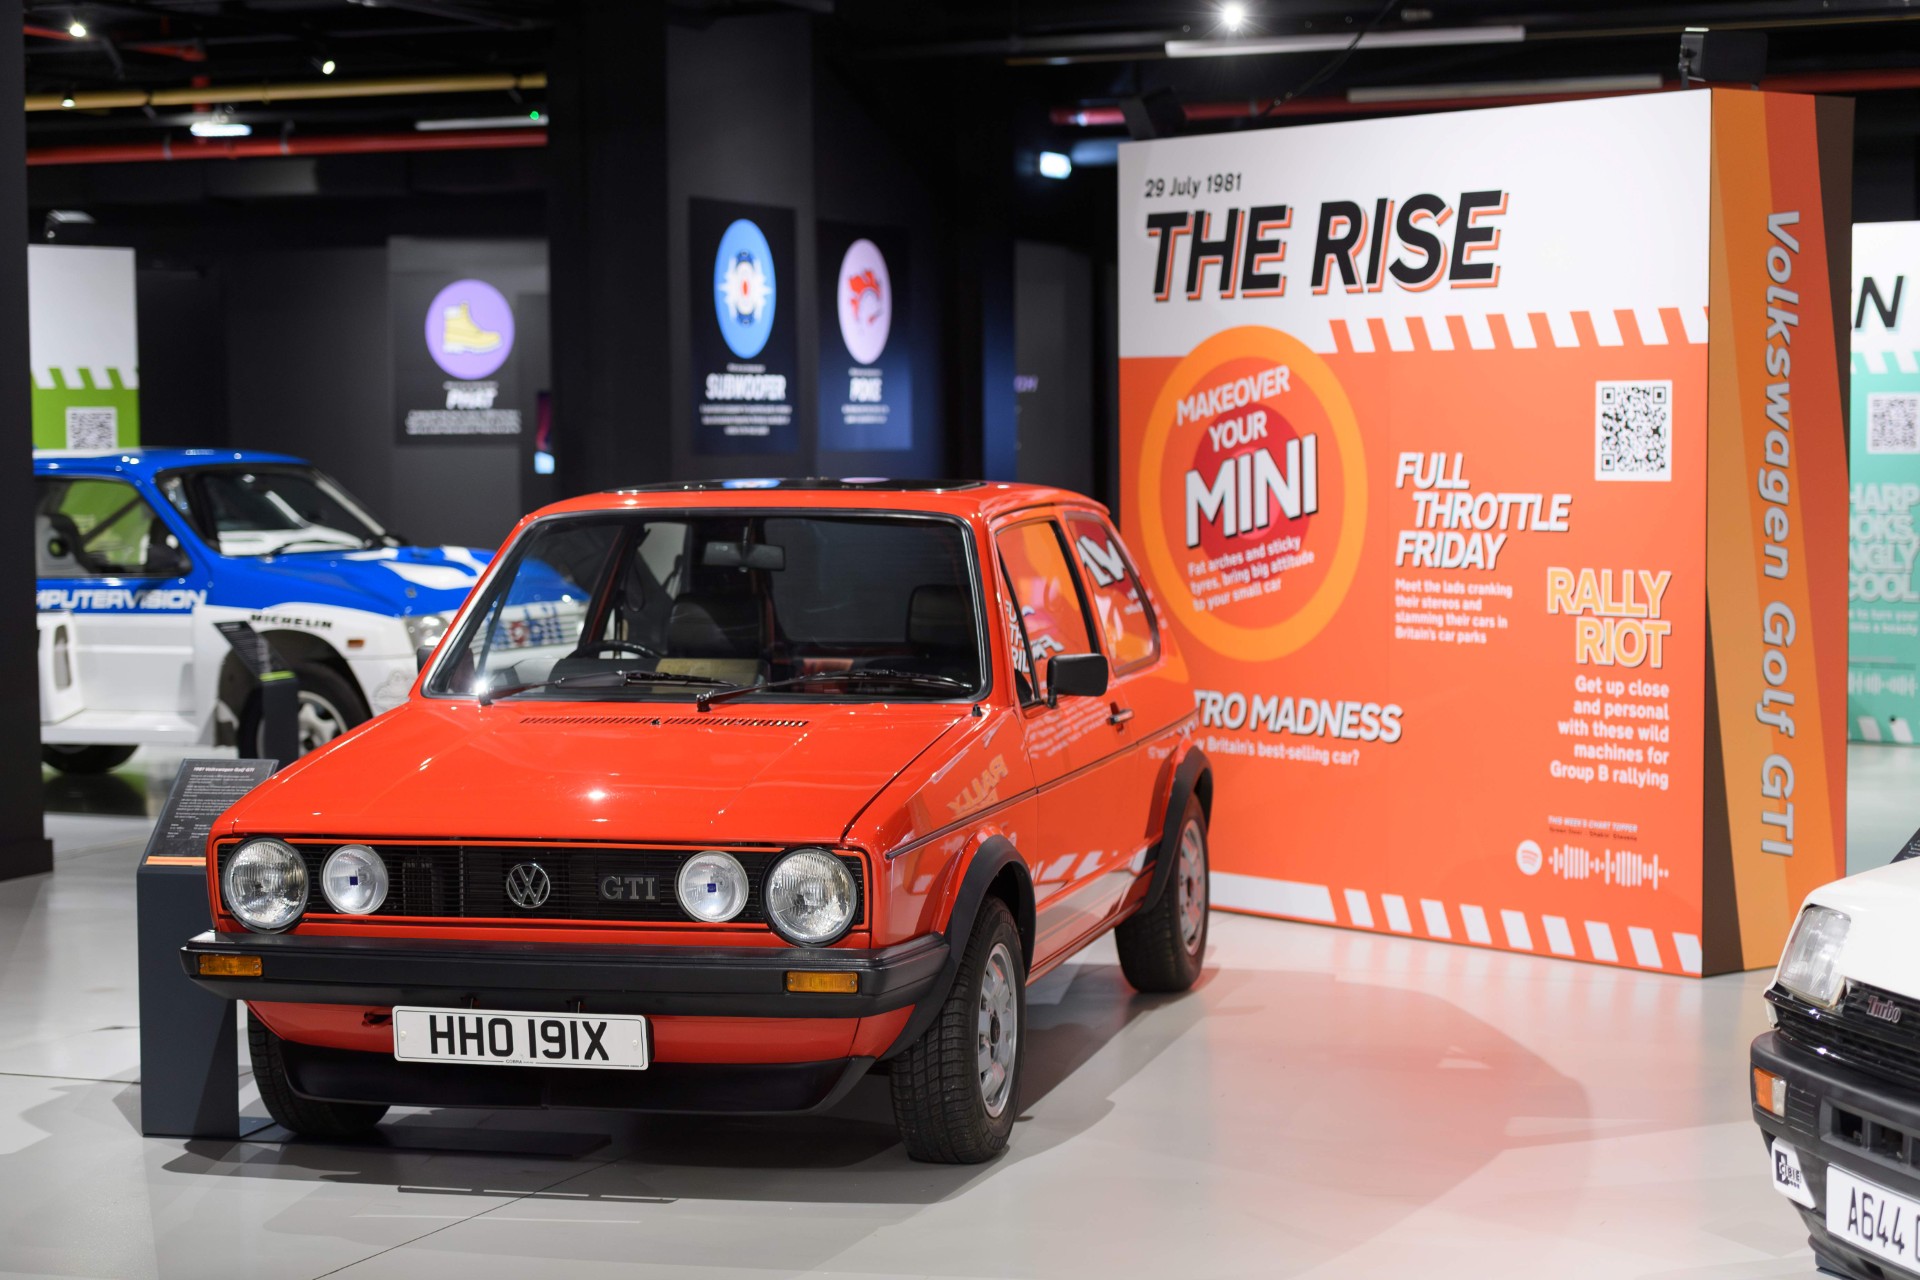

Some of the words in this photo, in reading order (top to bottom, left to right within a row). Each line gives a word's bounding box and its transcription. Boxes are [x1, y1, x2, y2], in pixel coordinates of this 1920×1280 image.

[1145, 179, 1164, 198] 29
[1168, 176, 1200, 198] July
[1206, 173, 1242, 193] 1981
[1147, 205, 1293, 301] THE
[1311, 190, 1509, 295] RISE
[1177, 365, 1290, 426] MAKEOVER
[1758, 210, 1800, 580] Volkswagen
[1209, 410, 1268, 452] YOUR
[1395, 452, 1470, 490] FULL
[1186, 433, 1318, 549] MINI
[1412, 491, 1573, 532] THROTTLE
[1188, 561, 1206, 577] Fat
[1208, 553, 1244, 573] arches
[1246, 543, 1267, 562] and
[1268, 536, 1301, 556] sticky
[1222, 566, 1250, 588] bring
[1251, 562, 1270, 583] big
[1271, 550, 1315, 574] attitude
[1395, 530, 1507, 571] FRIDAY
[1193, 597, 1205, 612] to
[1207, 593, 1231, 611] your
[1233, 582, 1263, 603] small
[1264, 577, 1281, 594] car
[1395, 578, 1422, 593] Meet
[1423, 579, 1441, 594] the
[1442, 580, 1466, 595] lads
[1467, 582, 1513, 599] cranking
[1395, 595, 1419, 609] their
[1421, 597, 1460, 611] stereos
[1462, 598, 1482, 612] and
[1547, 566, 1672, 620] RALLY
[251, 614, 332, 628] MICHELIN
[1395, 611, 1444, 628] slamming
[1446, 612, 1470, 627] their
[1472, 614, 1495, 629] cars
[1497, 615, 1508, 629] in
[1395, 627, 1437, 642] Britain's
[1438, 630, 1456, 643] car
[1458, 630, 1487, 645] parks
[1576, 617, 1672, 669] RIOT
[1575, 675, 1602, 695] Get
[1606, 680, 1625, 697] up
[1628, 679, 1670, 698] close
[1757, 601, 1796, 737] Golf
[1250, 695, 1404, 744] MADNESS
[1574, 699, 1600, 716] and
[1604, 701, 1670, 720] personal
[1558, 718, 1589, 737] with
[1592, 720, 1634, 740] these
[1638, 724, 1670, 743] wild
[1207, 736, 1255, 757] Britain's
[1257, 740, 1329, 766] best-selling
[1332, 749, 1360, 766] car?
[1574, 743, 1643, 763] machines
[1647, 746, 1670, 765] for
[1550, 760, 1595, 784] Group
[1598, 764, 1610, 782] B
[1613, 768, 1670, 791] rallying
[1761, 754, 1796, 857] GTI
[601, 874, 656, 901] GTI
[1866, 995, 1902, 1024] Turbo
[429, 1014, 514, 1058] HHO
[527, 1018, 610, 1061] 191X
[1847, 1186, 1905, 1255] A644
